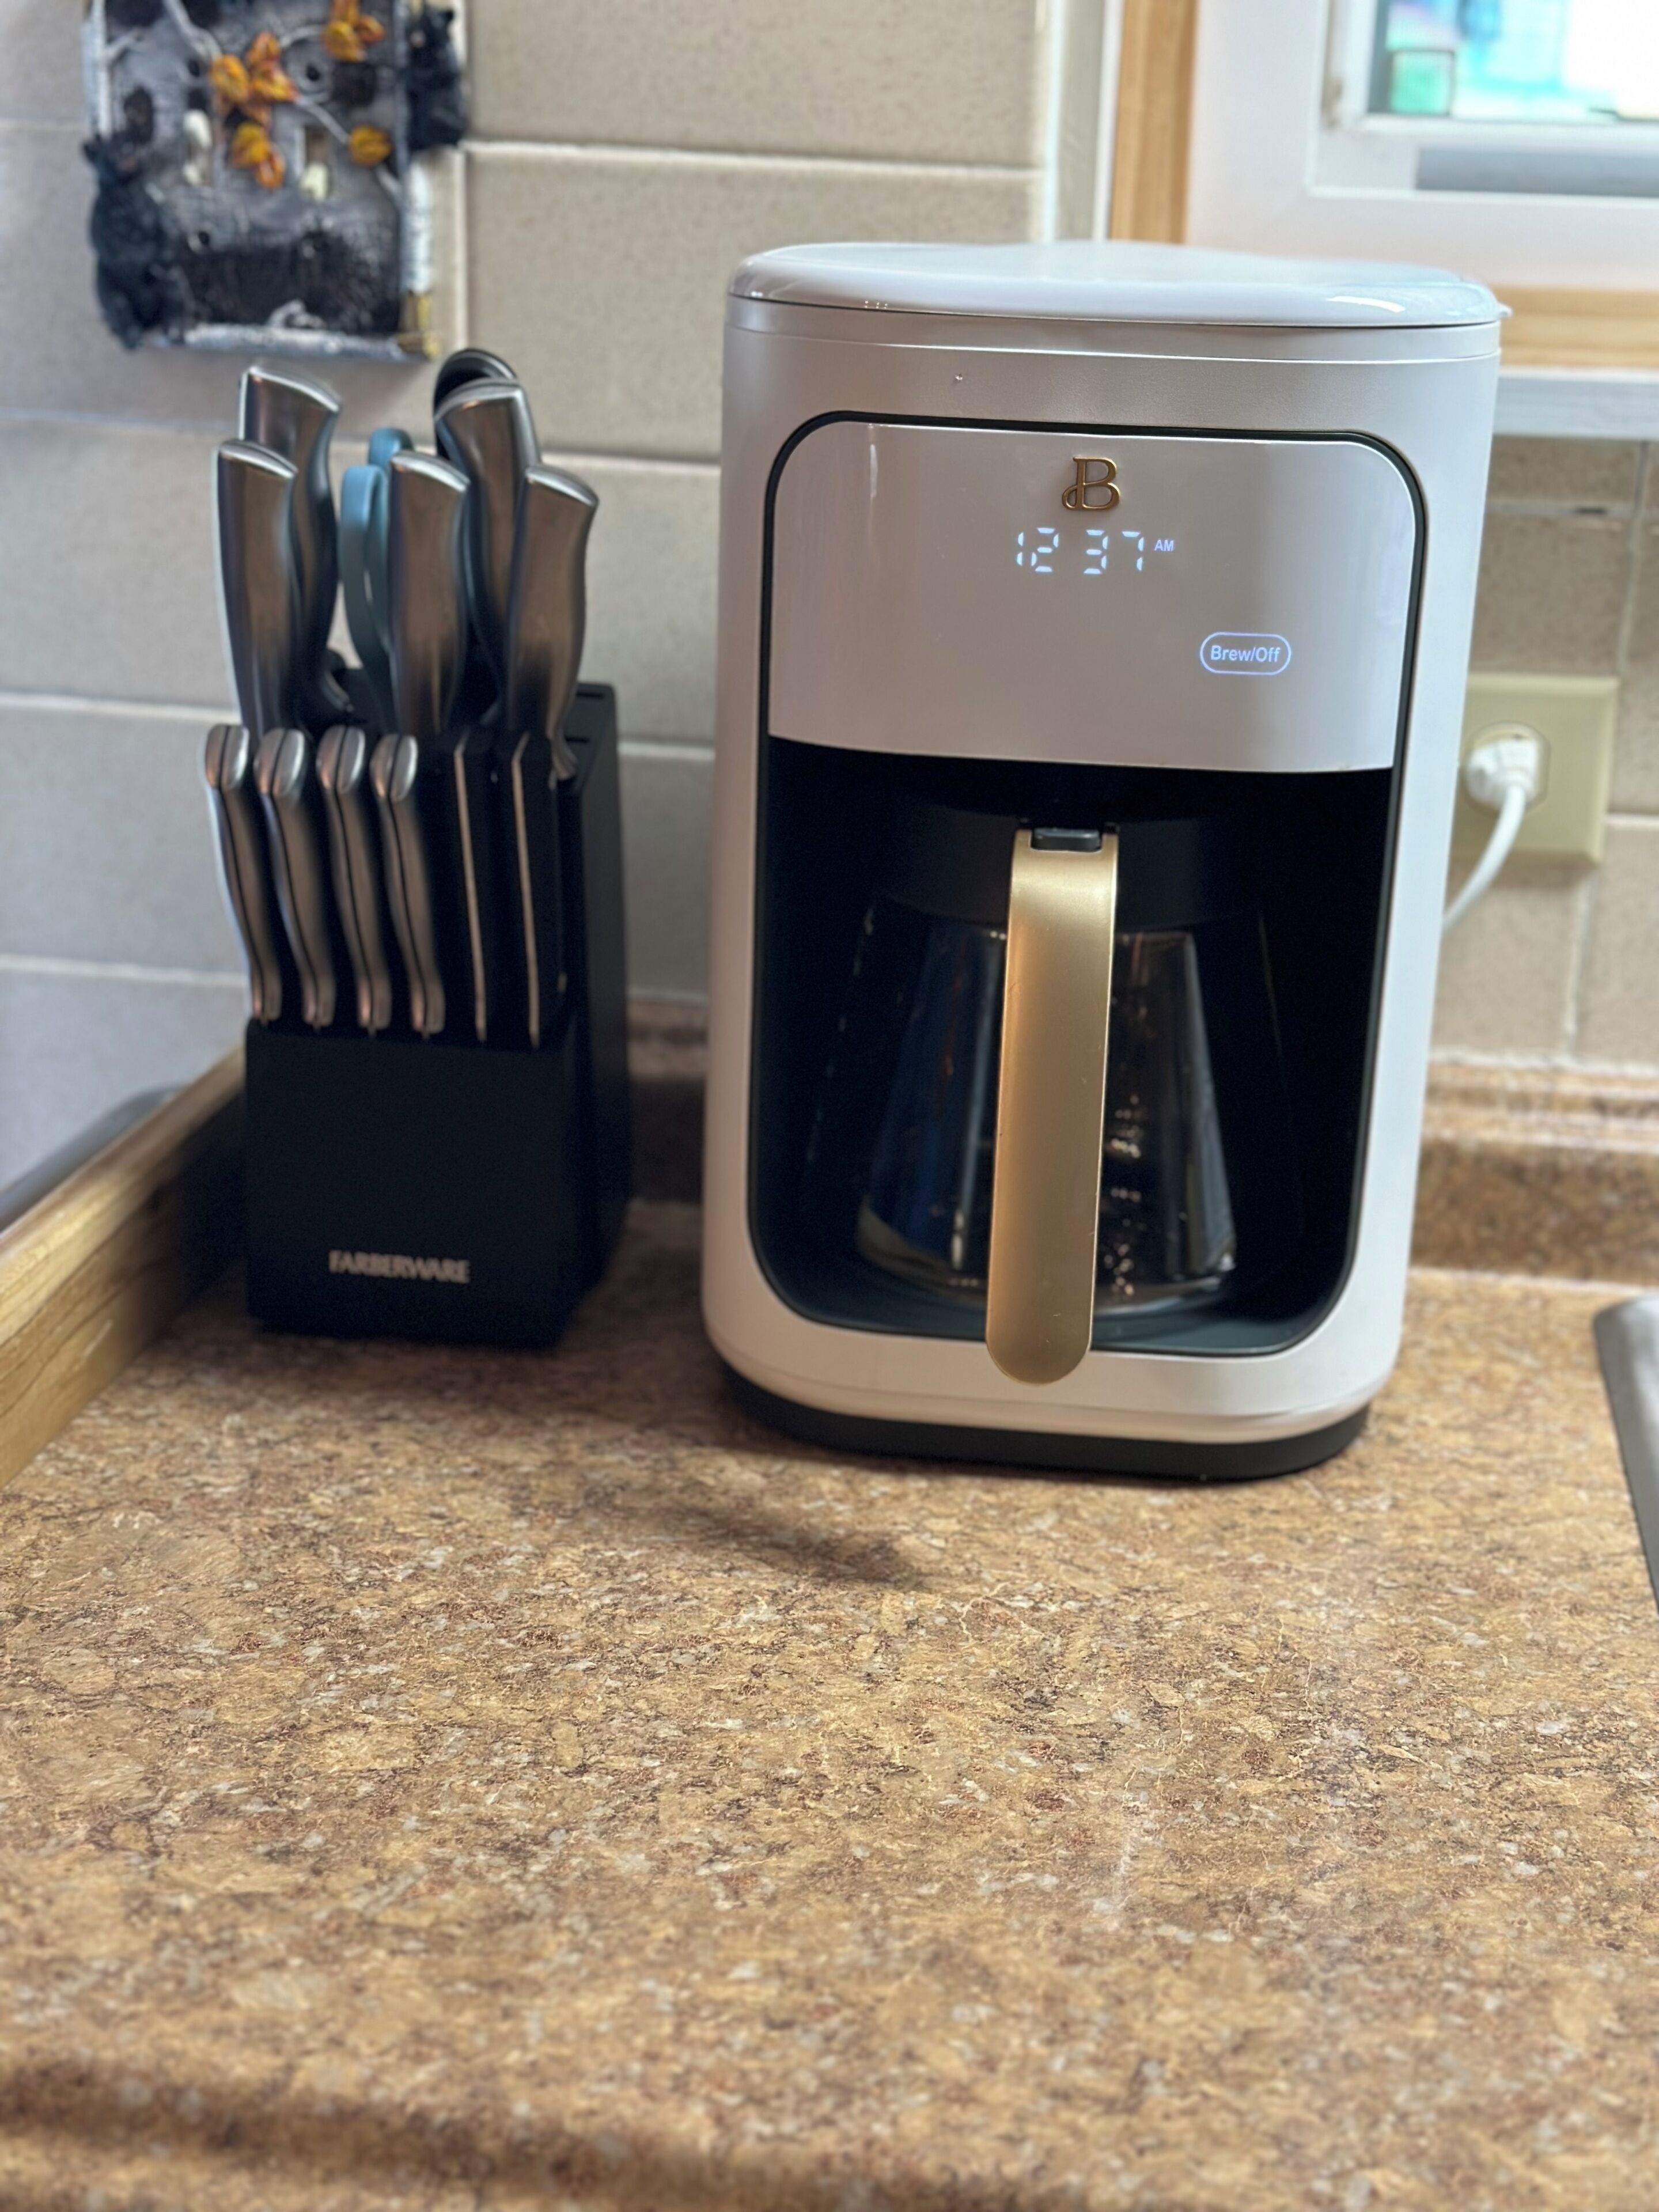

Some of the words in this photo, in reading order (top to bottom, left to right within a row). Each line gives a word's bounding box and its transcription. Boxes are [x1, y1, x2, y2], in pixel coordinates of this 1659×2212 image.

[1062, 456, 1121, 511] B
[1154, 540, 1175, 552] AM
[1210, 645, 1280, 663] Brew/Off
[329, 1249, 470, 1284] FARBERWARE
